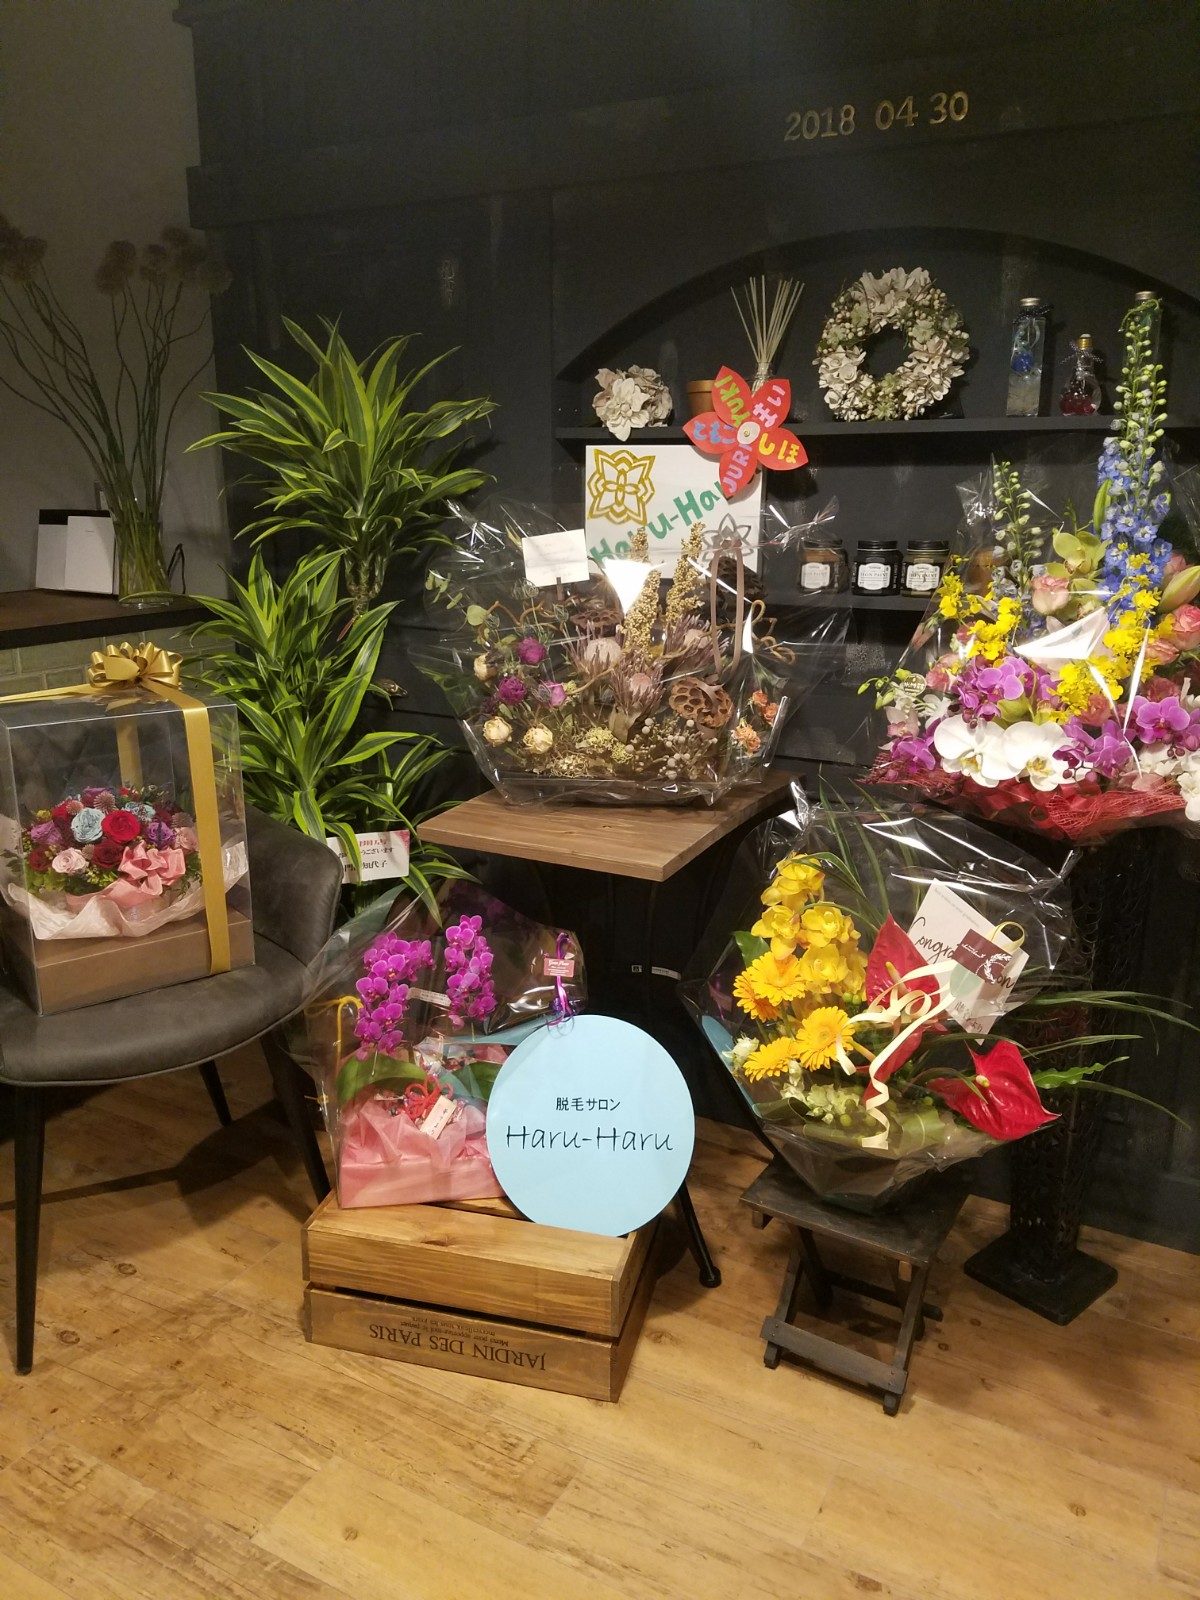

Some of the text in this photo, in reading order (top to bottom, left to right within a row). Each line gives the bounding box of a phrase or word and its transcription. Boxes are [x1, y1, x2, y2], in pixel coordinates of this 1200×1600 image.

[784, 91, 969, 142] 2018 04 30
[714, 375, 746, 428] YUKI
[752, 385, 786, 428] まい
[758, 433, 800, 464] しほ
[555, 1097, 621, 1111] 脱毛サロン
[506, 1125, 674, 1152] Haru-Haru
[369, 1324, 546, 1371] JARDIN DES PARIS
